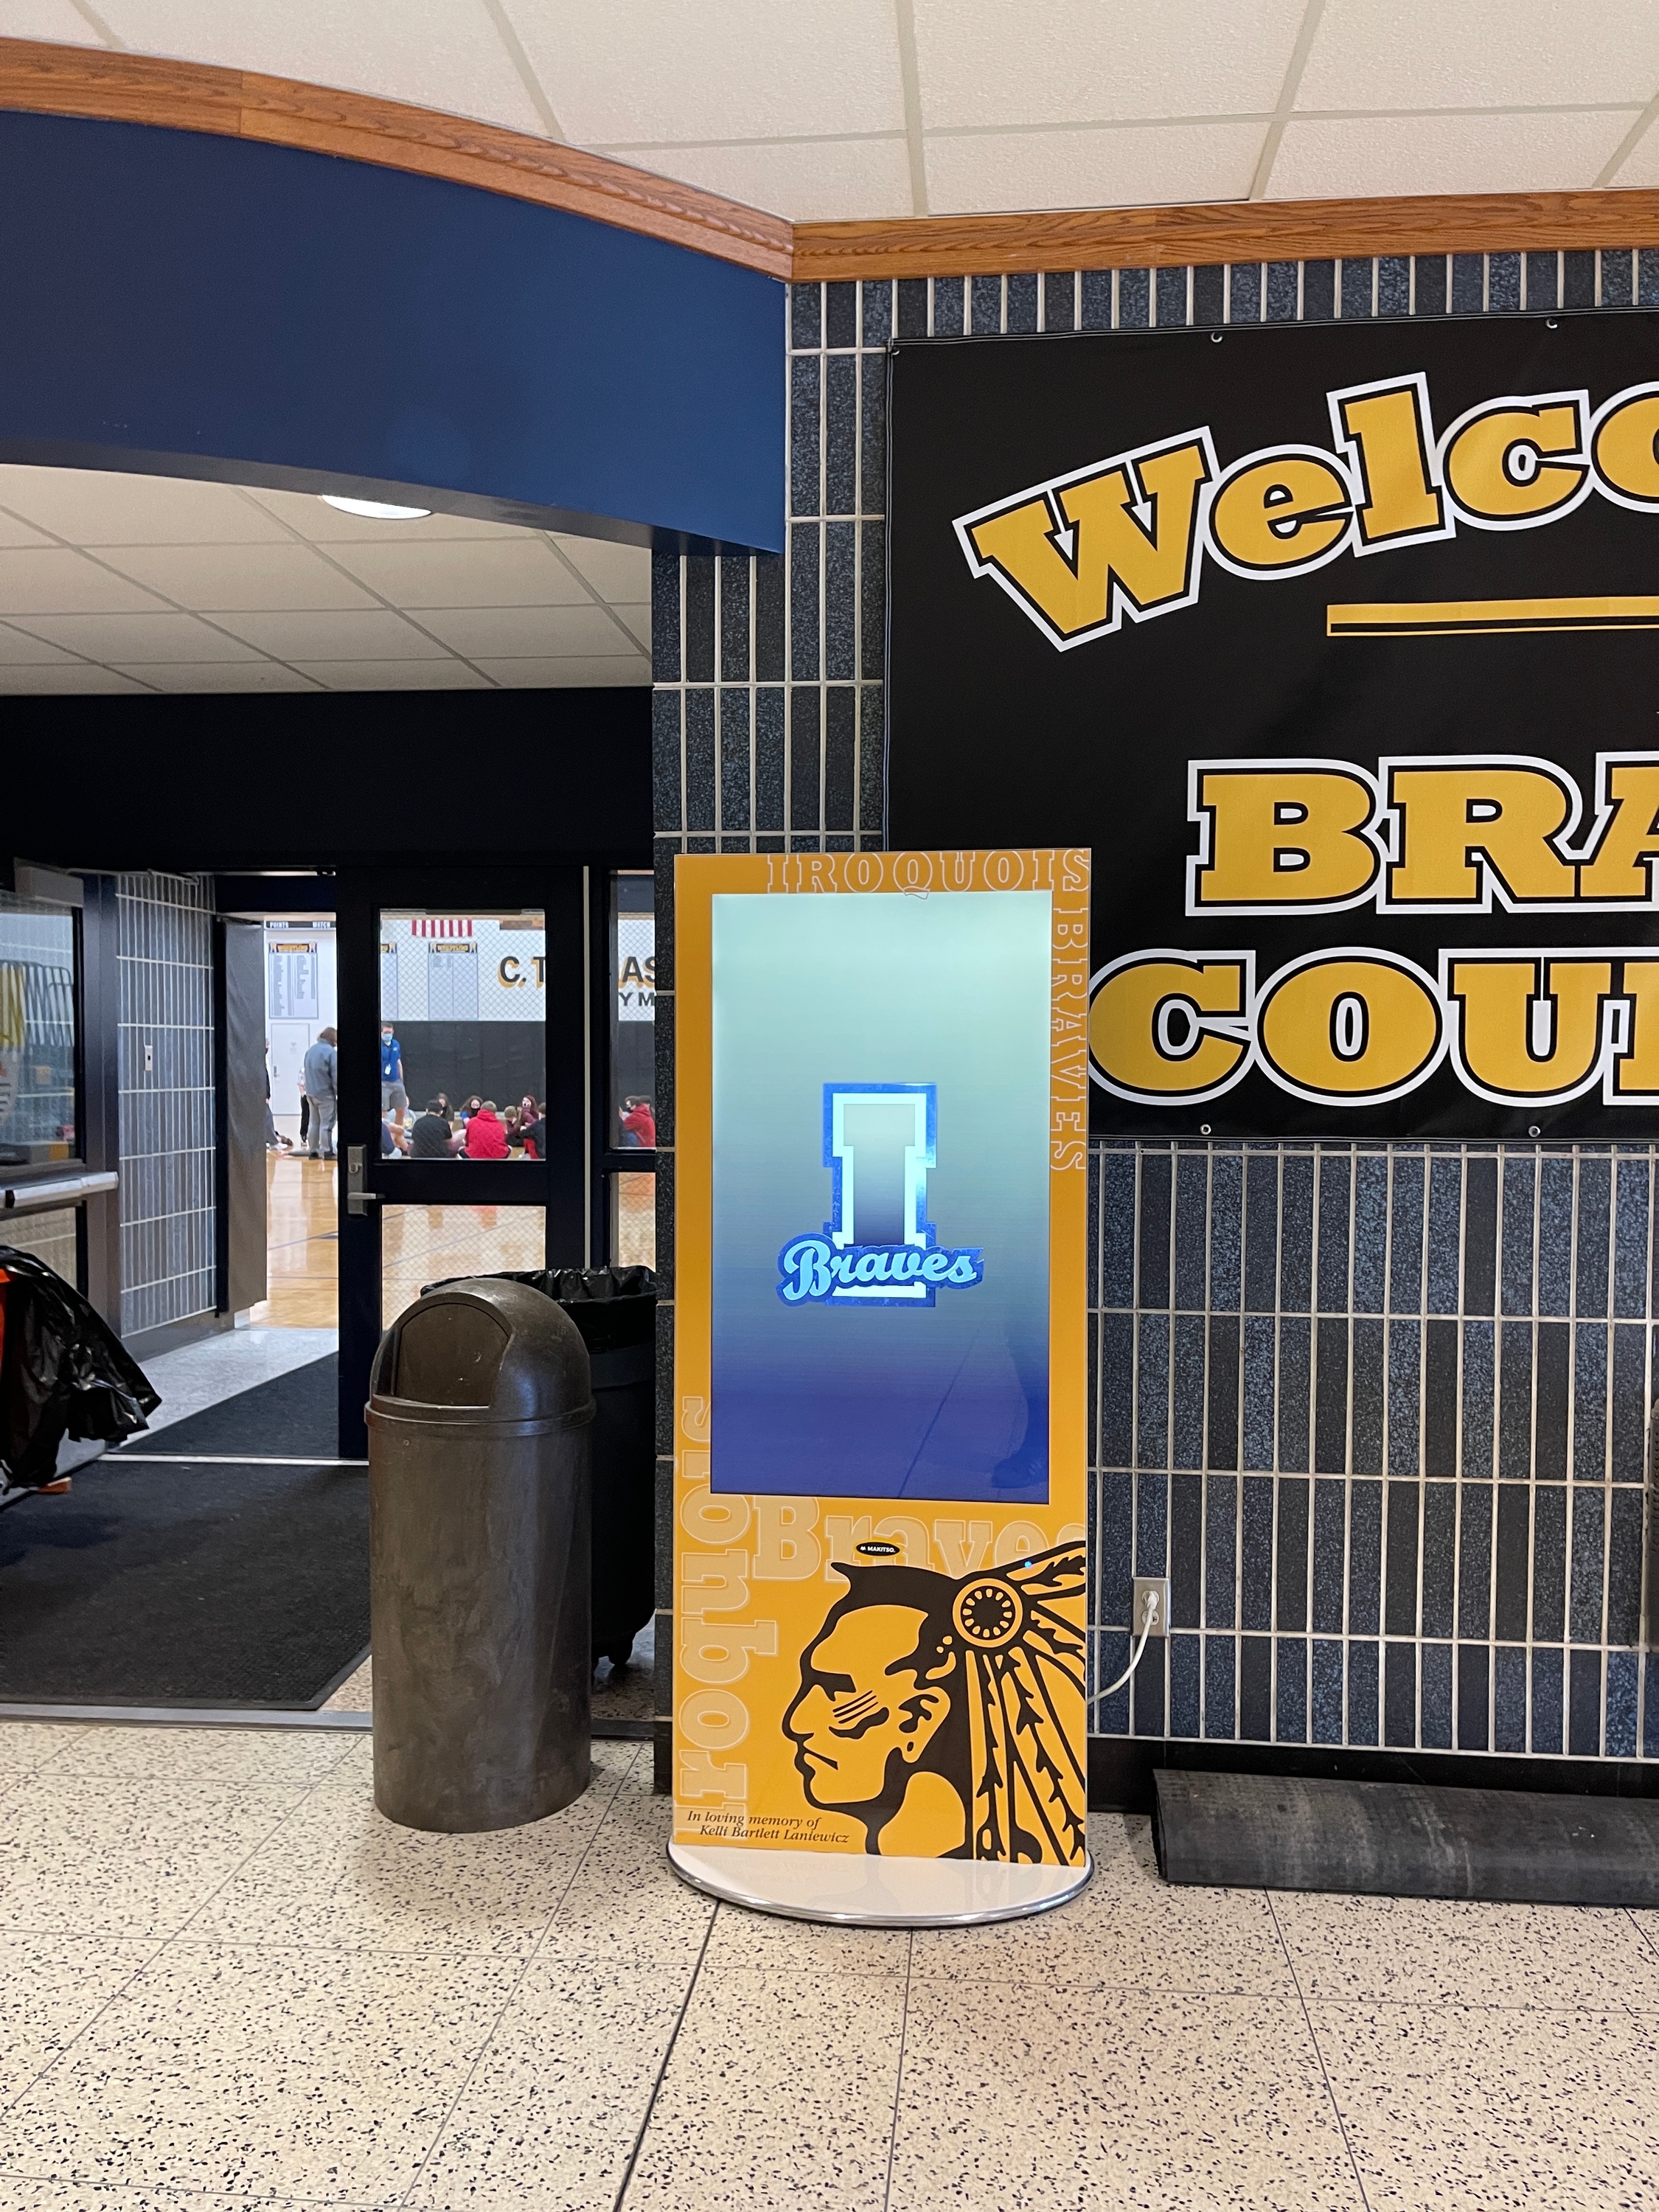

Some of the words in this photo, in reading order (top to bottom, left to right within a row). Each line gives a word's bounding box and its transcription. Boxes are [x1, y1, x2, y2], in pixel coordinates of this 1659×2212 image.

[767, 849, 1089, 900] IROQUOIS
[1050, 907, 1089, 1171] BRAVES
[1089, 947, 1659, 1107] COU
[777, 1235, 982, 1305] Braves
[753, 1495, 1085, 1583] Brave
[687, 1810, 700, 1821] In
[705, 1812, 745, 1826] loving
[748, 1816, 803, 1829] memory
[807, 1818, 822, 1831] of
[700, 1825, 728, 1836] Kelli
[731, 1826, 780, 1839] Bartlett
[783, 1829, 850, 1843] Laniewicz
